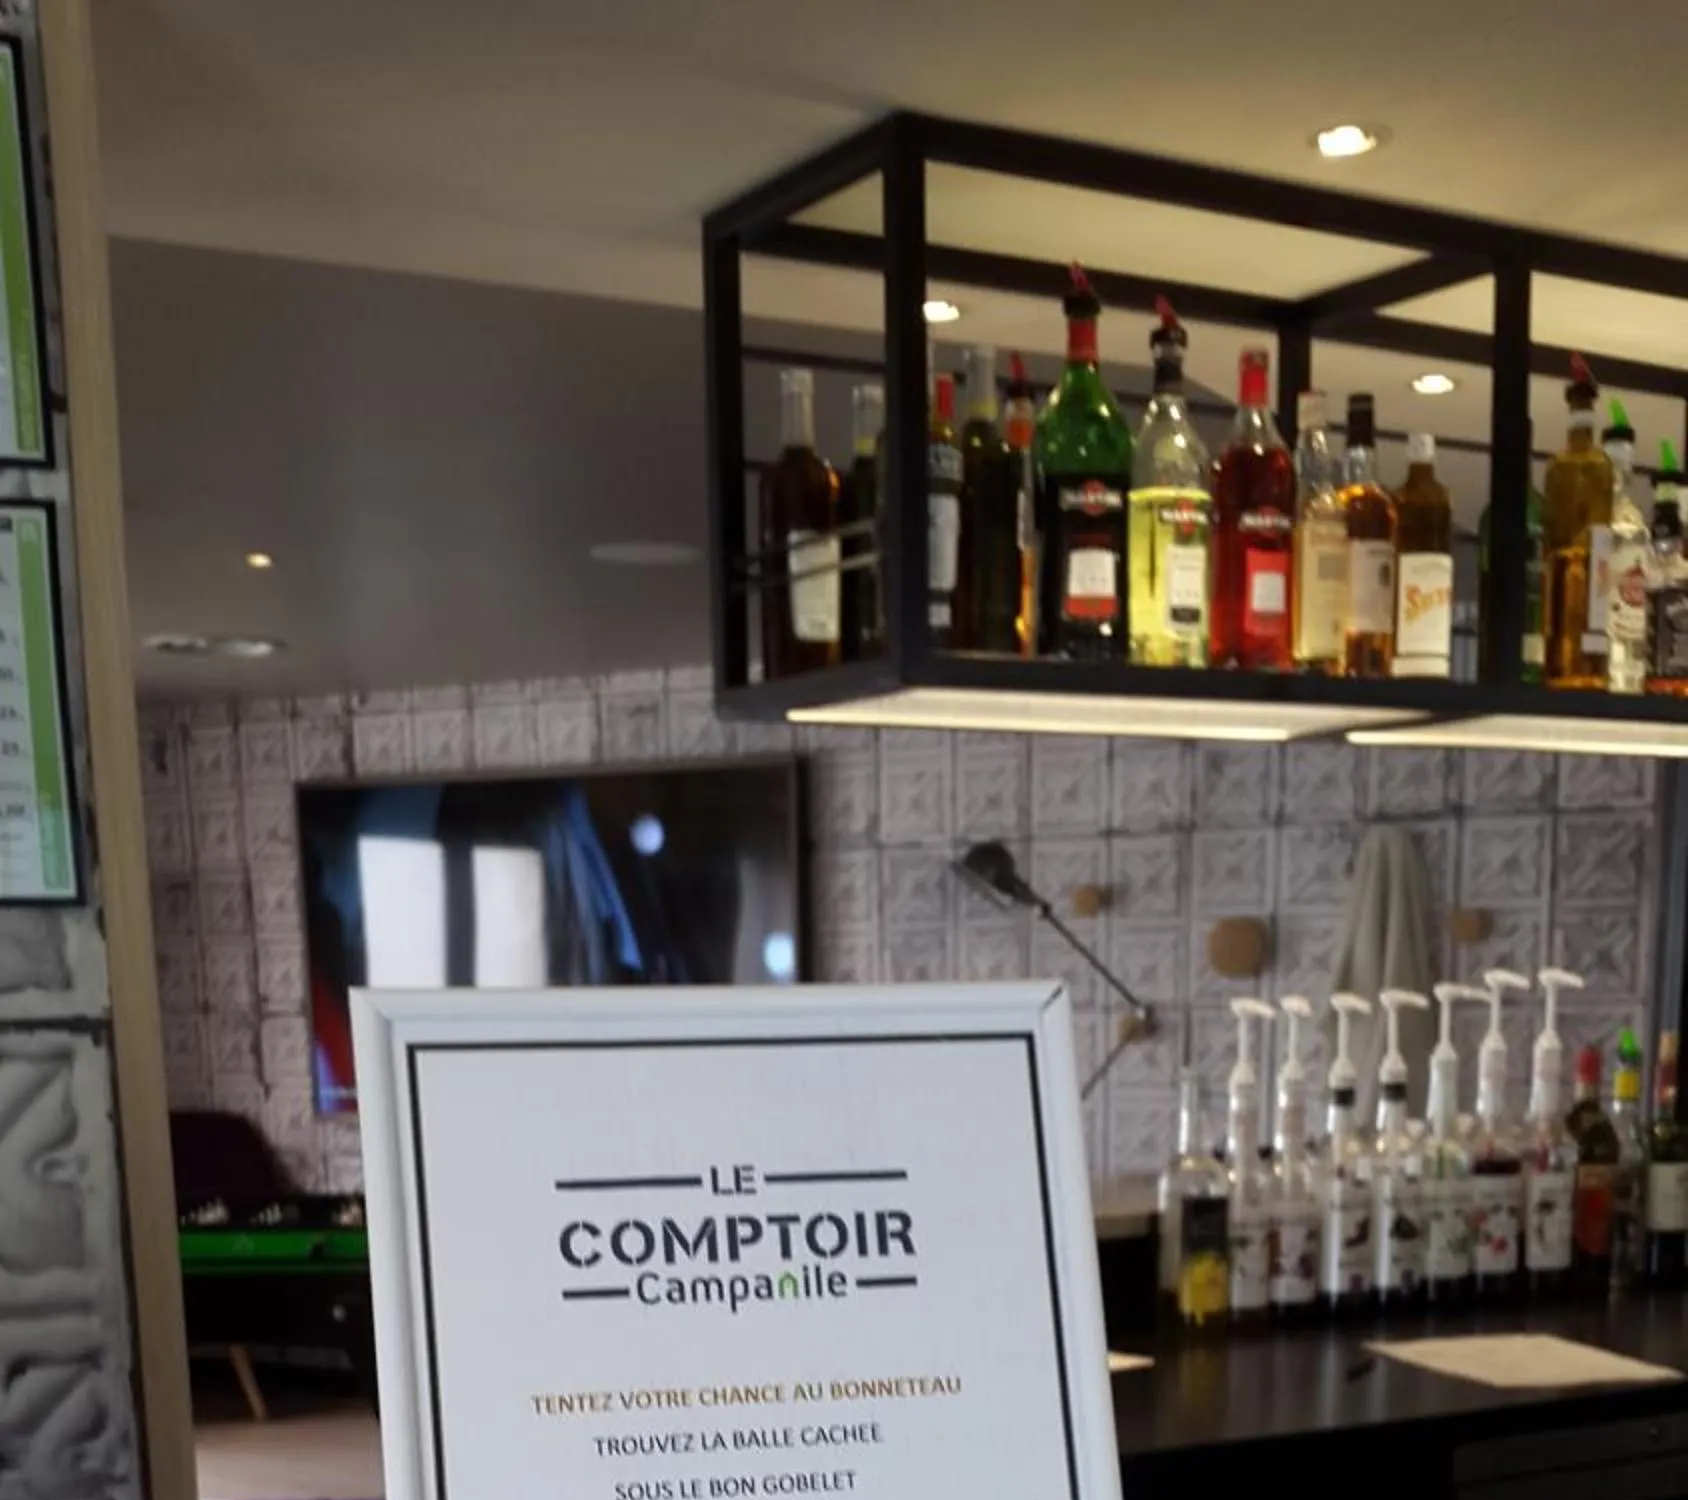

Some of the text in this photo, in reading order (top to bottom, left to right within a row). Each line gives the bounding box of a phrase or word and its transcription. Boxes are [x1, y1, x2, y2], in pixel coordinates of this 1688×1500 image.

[709, 1164, 757, 1197] LE
[558, 1209, 916, 1269] COMPTOIR
[635, 1264, 849, 1314] Campanile
[533, 1375, 962, 1415] TENTEZ VOTRE CHANCE AU BONNETEAU
[593, 1432, 694, 1457] TROUVEZ
[700, 1430, 728, 1452] LA
[732, 1426, 795, 1450] BALLE
[679, 1478, 703, 1500] LE
[709, 1475, 756, 1498] BON
[762, 1469, 857, 1496] GOBELET
